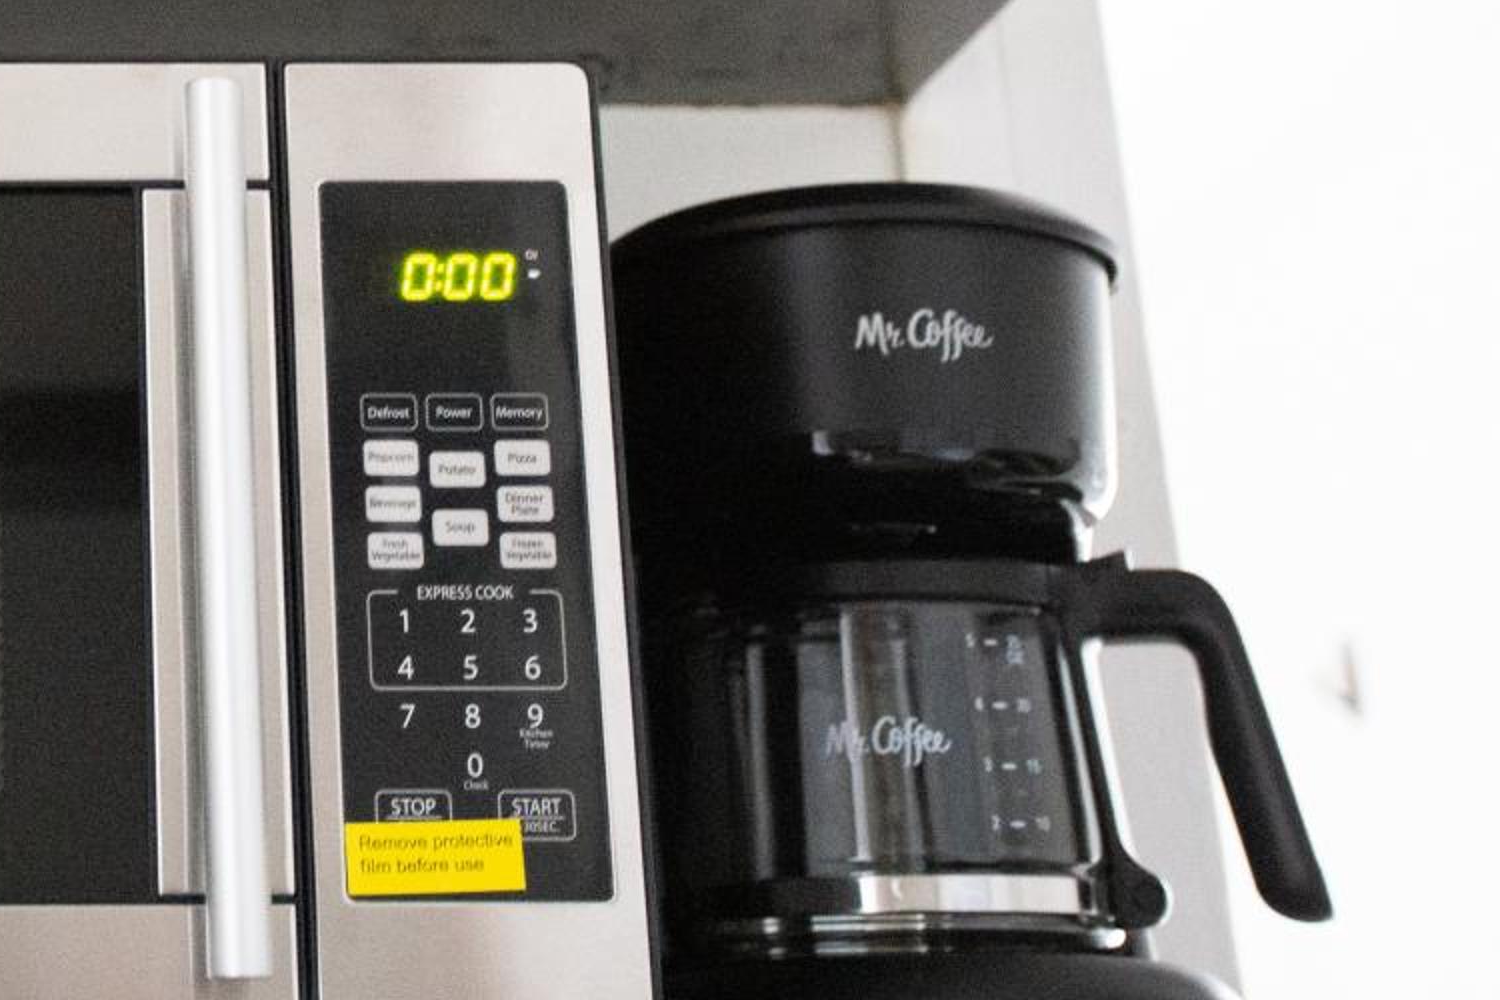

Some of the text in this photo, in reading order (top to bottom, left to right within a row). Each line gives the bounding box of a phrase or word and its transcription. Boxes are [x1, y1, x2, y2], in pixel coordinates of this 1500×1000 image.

[401, 252, 517, 301] 0:00
[854, 308, 995, 363] Mr. Coffee
[367, 405, 411, 421] Defrost
[435, 405, 473, 420] Power
[495, 405, 543, 423] Memory
[367, 450, 415, 465] Popcorn
[507, 452, 538, 465] Pizza
[437, 463, 477, 476] Potato
[369, 497, 417, 511] Beverage
[504, 492, 544, 504] Dinner
[511, 504, 540, 516] Plate
[445, 520, 476, 535] Soup
[381, 537, 409, 549] Fresh
[511, 537, 544, 549] Frozen
[371, 549, 422, 563] Vegetable
[416, 583, 515, 601] EXPRESS COOK
[399, 607, 539, 634] 1 2 3
[397, 655, 542, 681] 4 5 6
[399, 703, 544, 730] 7 8 9
[871, 715, 951, 767] Coffee
[466, 752, 484, 779] 0
[463, 780, 489, 792] Clock
[391, 799, 437, 816] STOP
[511, 797, 562, 816] START
[358, 831, 514, 852] Remove protective
[359, 855, 486, 874] film before use
